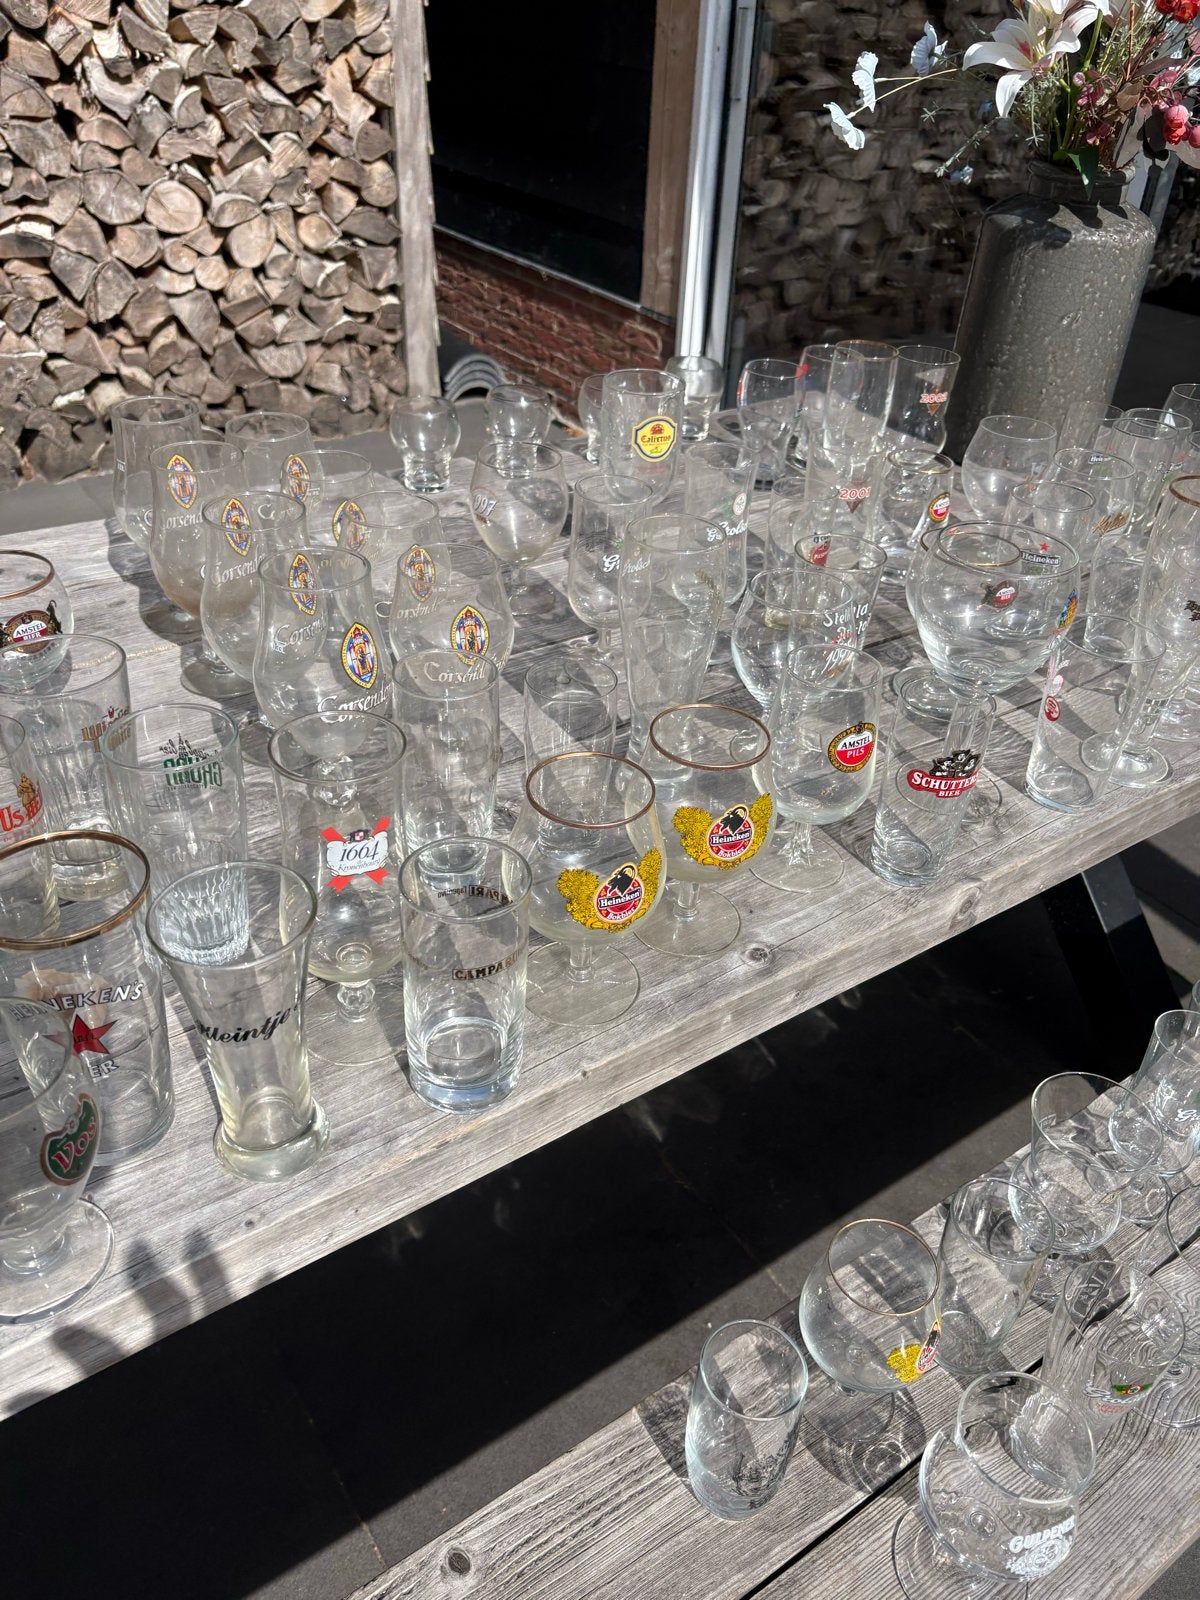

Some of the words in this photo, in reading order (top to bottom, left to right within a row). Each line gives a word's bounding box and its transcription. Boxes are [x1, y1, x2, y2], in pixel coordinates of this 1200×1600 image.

[1022, 552, 1060, 565] Heineken
[15, 622, 43, 637] AMSTEL
[22, 632, 42, 641] BIER
[841, 735, 870, 750] AMSTEL
[846, 747, 865, 759] PILS
[938, 790, 961, 798] BIER
[712, 832, 751, 845] Heineken
[339, 840, 380, 862] 1664
[717, 846, 746, 858] Bokbier
[599, 890, 641, 908] Heineken
[606, 907, 636, 921] Bokbier
